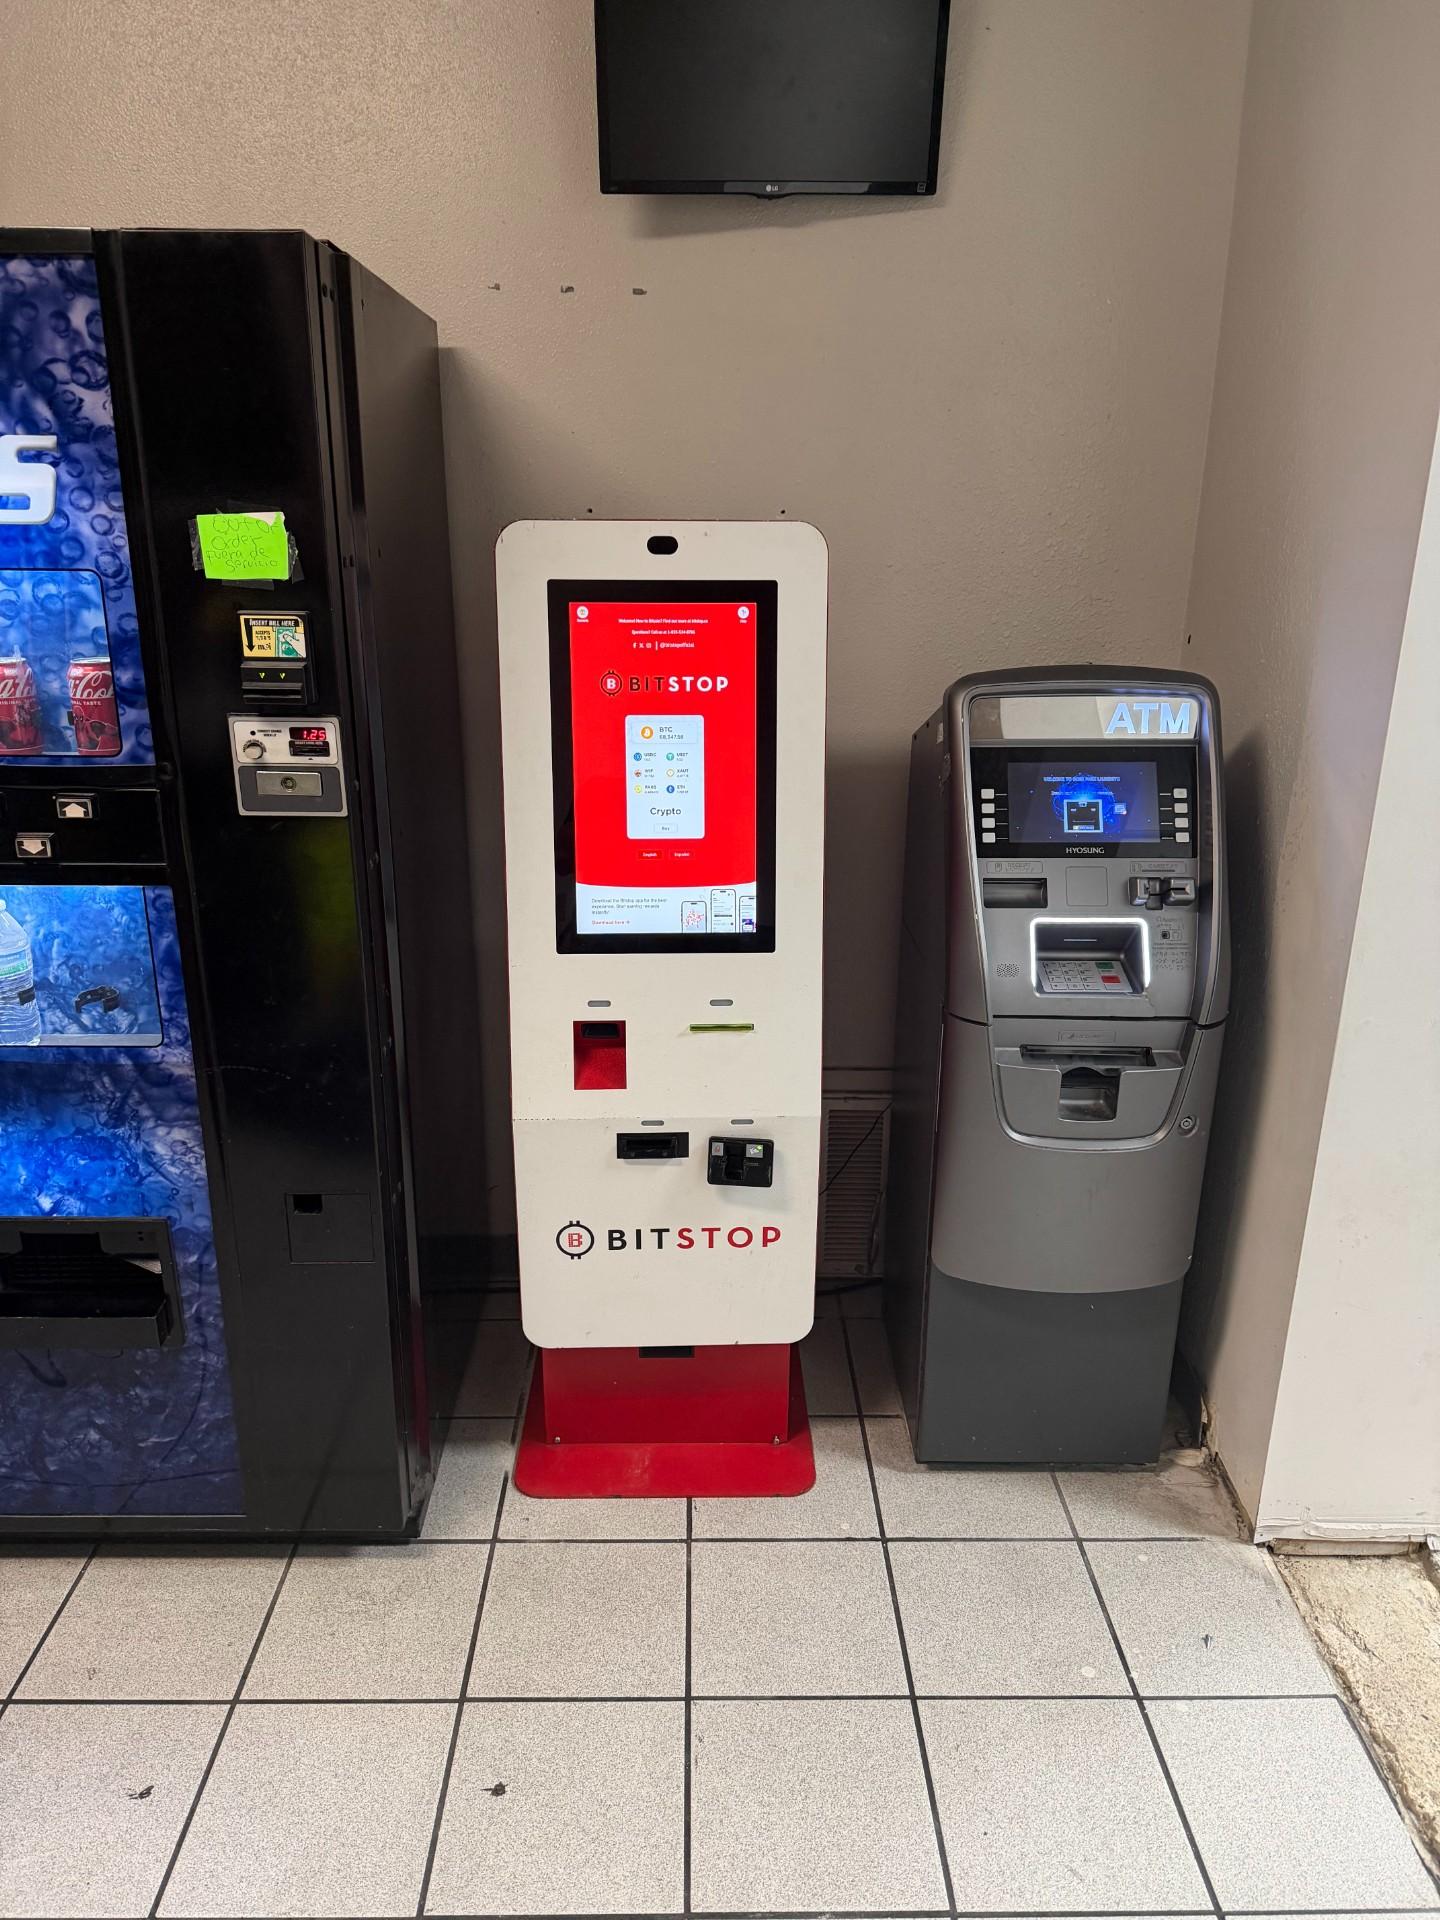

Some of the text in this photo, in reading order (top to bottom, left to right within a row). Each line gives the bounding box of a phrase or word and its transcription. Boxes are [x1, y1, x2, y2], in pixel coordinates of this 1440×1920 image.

[629, 676, 729, 692] BITSTOP
[1104, 702, 1190, 734] ATM
[303, 729, 326, 741] 1.25
[649, 807, 682, 816] Crypto
[607, 1226, 782, 1251] BITSTOP
